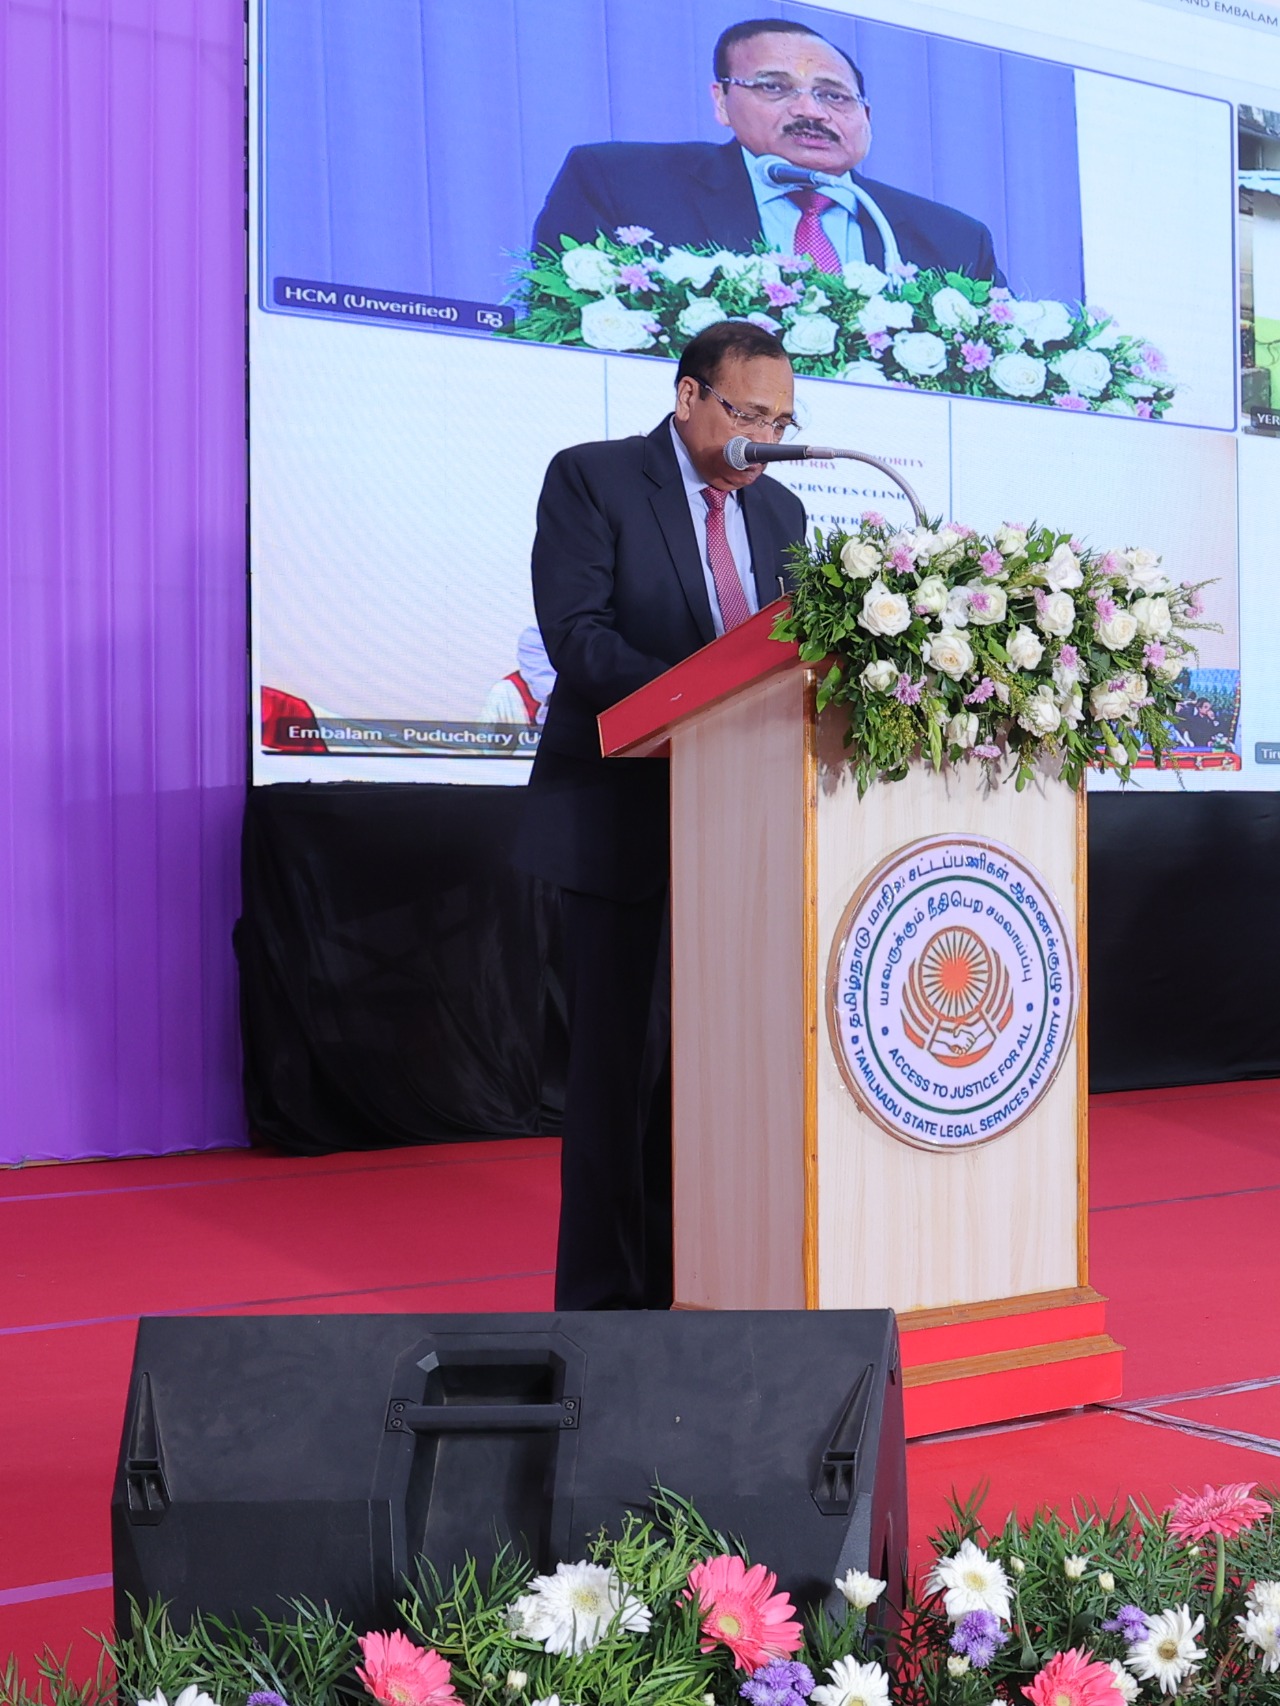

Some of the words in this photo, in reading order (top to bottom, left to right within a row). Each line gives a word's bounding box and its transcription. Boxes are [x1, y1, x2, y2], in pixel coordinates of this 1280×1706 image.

[1214, 2, 1278, 27] EMBALAM
[285, 285, 337, 305] HCM
[343, 293, 459, 322] (Unverified)
[790, 482, 859, 496] SERVICES
[288, 725, 382, 741] Embalam
[403, 728, 513, 746] Puducherry
[854, 1045, 901, 1117] TAMILNADU
[902, 1111, 937, 1137] STATE
[940, 1123, 978, 1138] LEGAL
[979, 1087, 1030, 1132] SERVICES
[1029, 1011, 1061, 1089] AUTHORITY
[888, 1048, 929, 1092] ACCESS
[933, 1085, 948, 1098] TO
[950, 1072, 999, 1099] JUSTICE
[998, 1051, 1020, 1077] FOR
[1017, 1022, 1033, 1055] ALL
